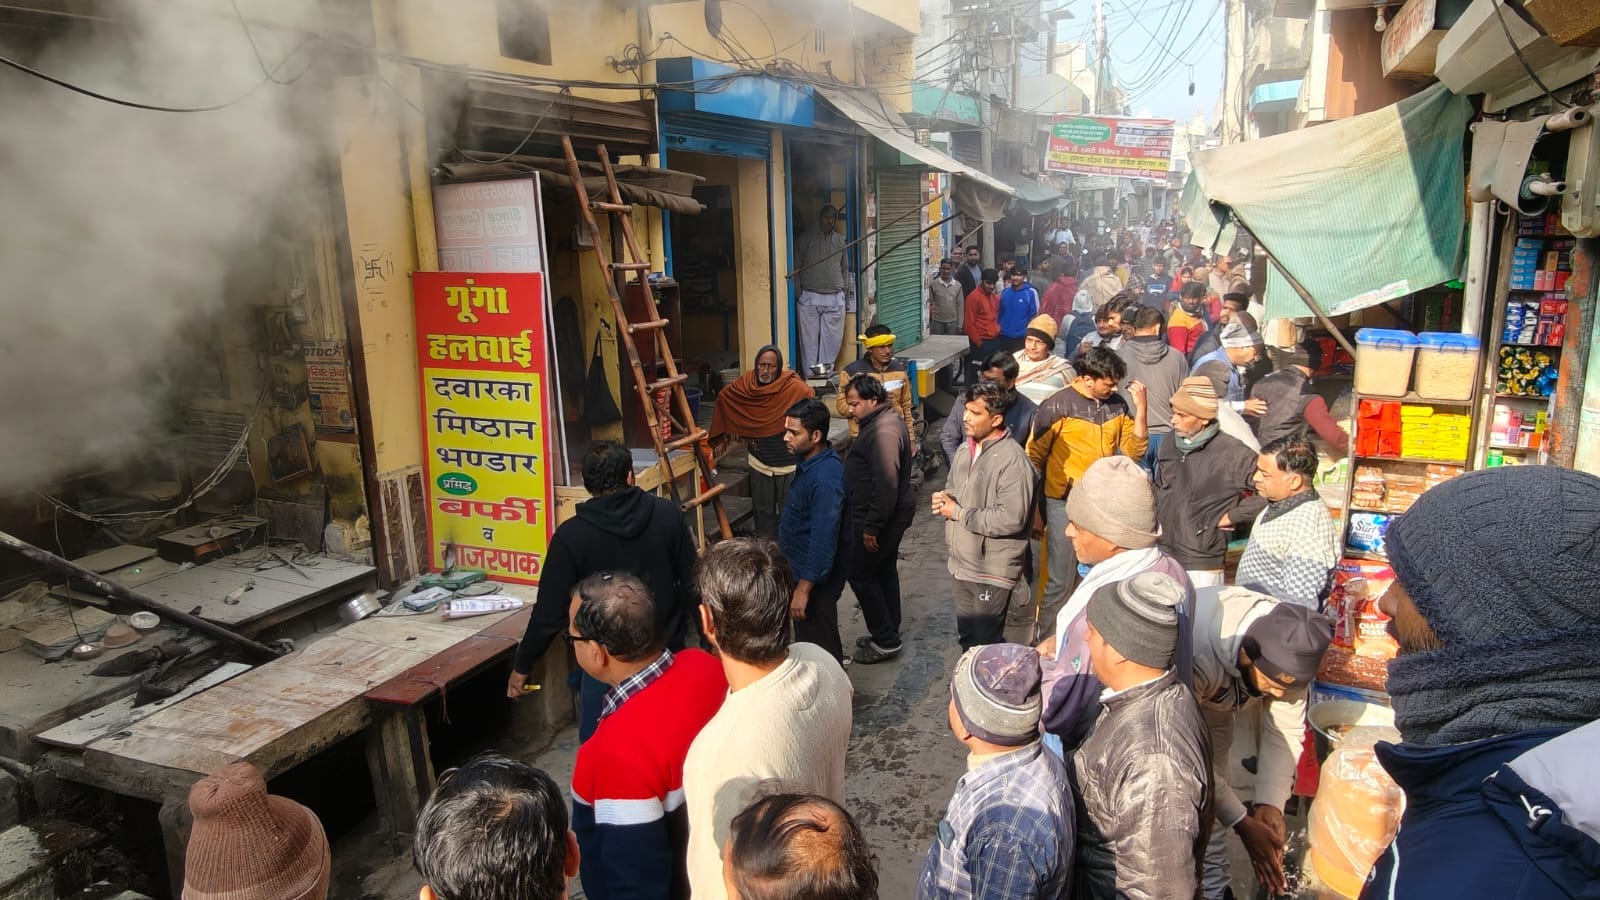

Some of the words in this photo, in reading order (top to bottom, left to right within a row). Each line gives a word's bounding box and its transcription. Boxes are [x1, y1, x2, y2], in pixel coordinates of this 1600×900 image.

[444, 278, 510, 323] गूंगा
[427, 329, 533, 368] हलवाई
[431, 377, 533, 402] दवारका
[432, 408, 537, 440] मिष्ठान
[436, 447, 538, 475] भण्डार
[437, 496, 541, 525] बर्फी
[482, 527, 495, 542] व
